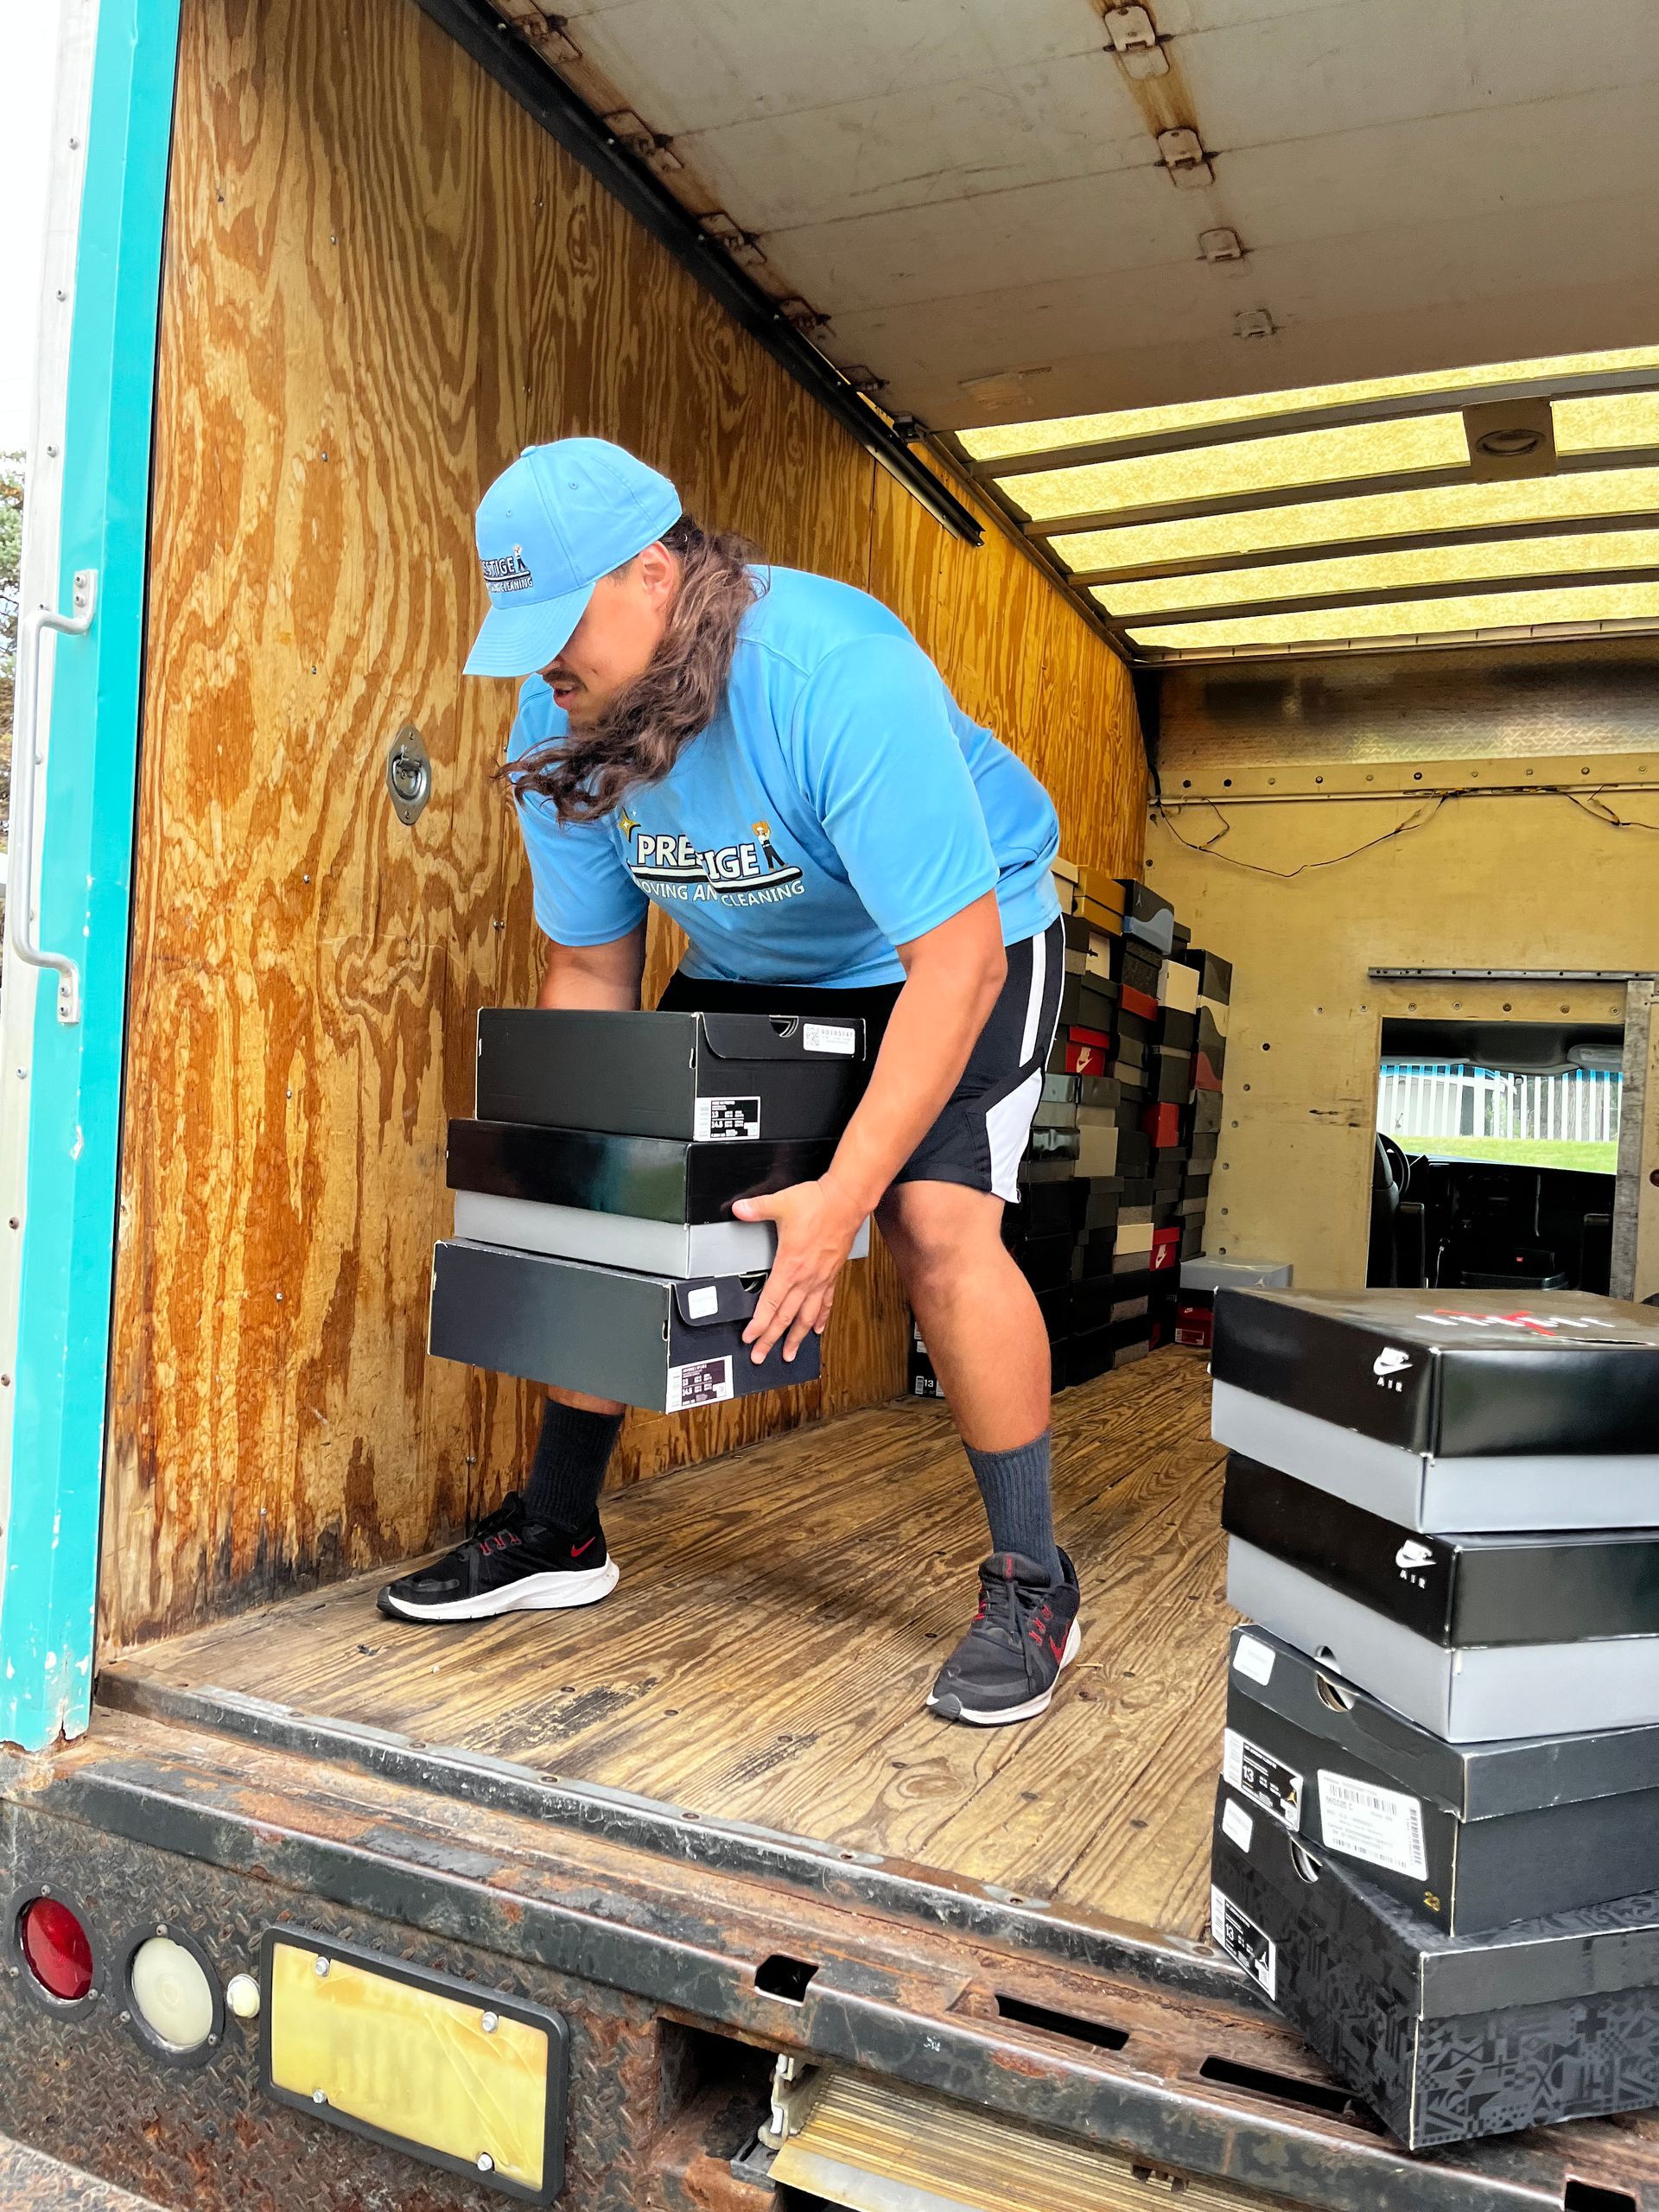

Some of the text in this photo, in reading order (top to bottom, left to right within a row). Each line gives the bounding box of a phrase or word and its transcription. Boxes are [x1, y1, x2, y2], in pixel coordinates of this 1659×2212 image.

[637, 833, 761, 880] PREIGE
[721, 880, 805, 907] CLEANING
[924, 1379, 934, 1388] 13
[1376, 1376, 1402, 1392] AIR
[1400, 1569, 1426, 1589] AIR
[1243, 1765, 1255, 1783] 13
[1225, 1923, 1234, 1942] 13
